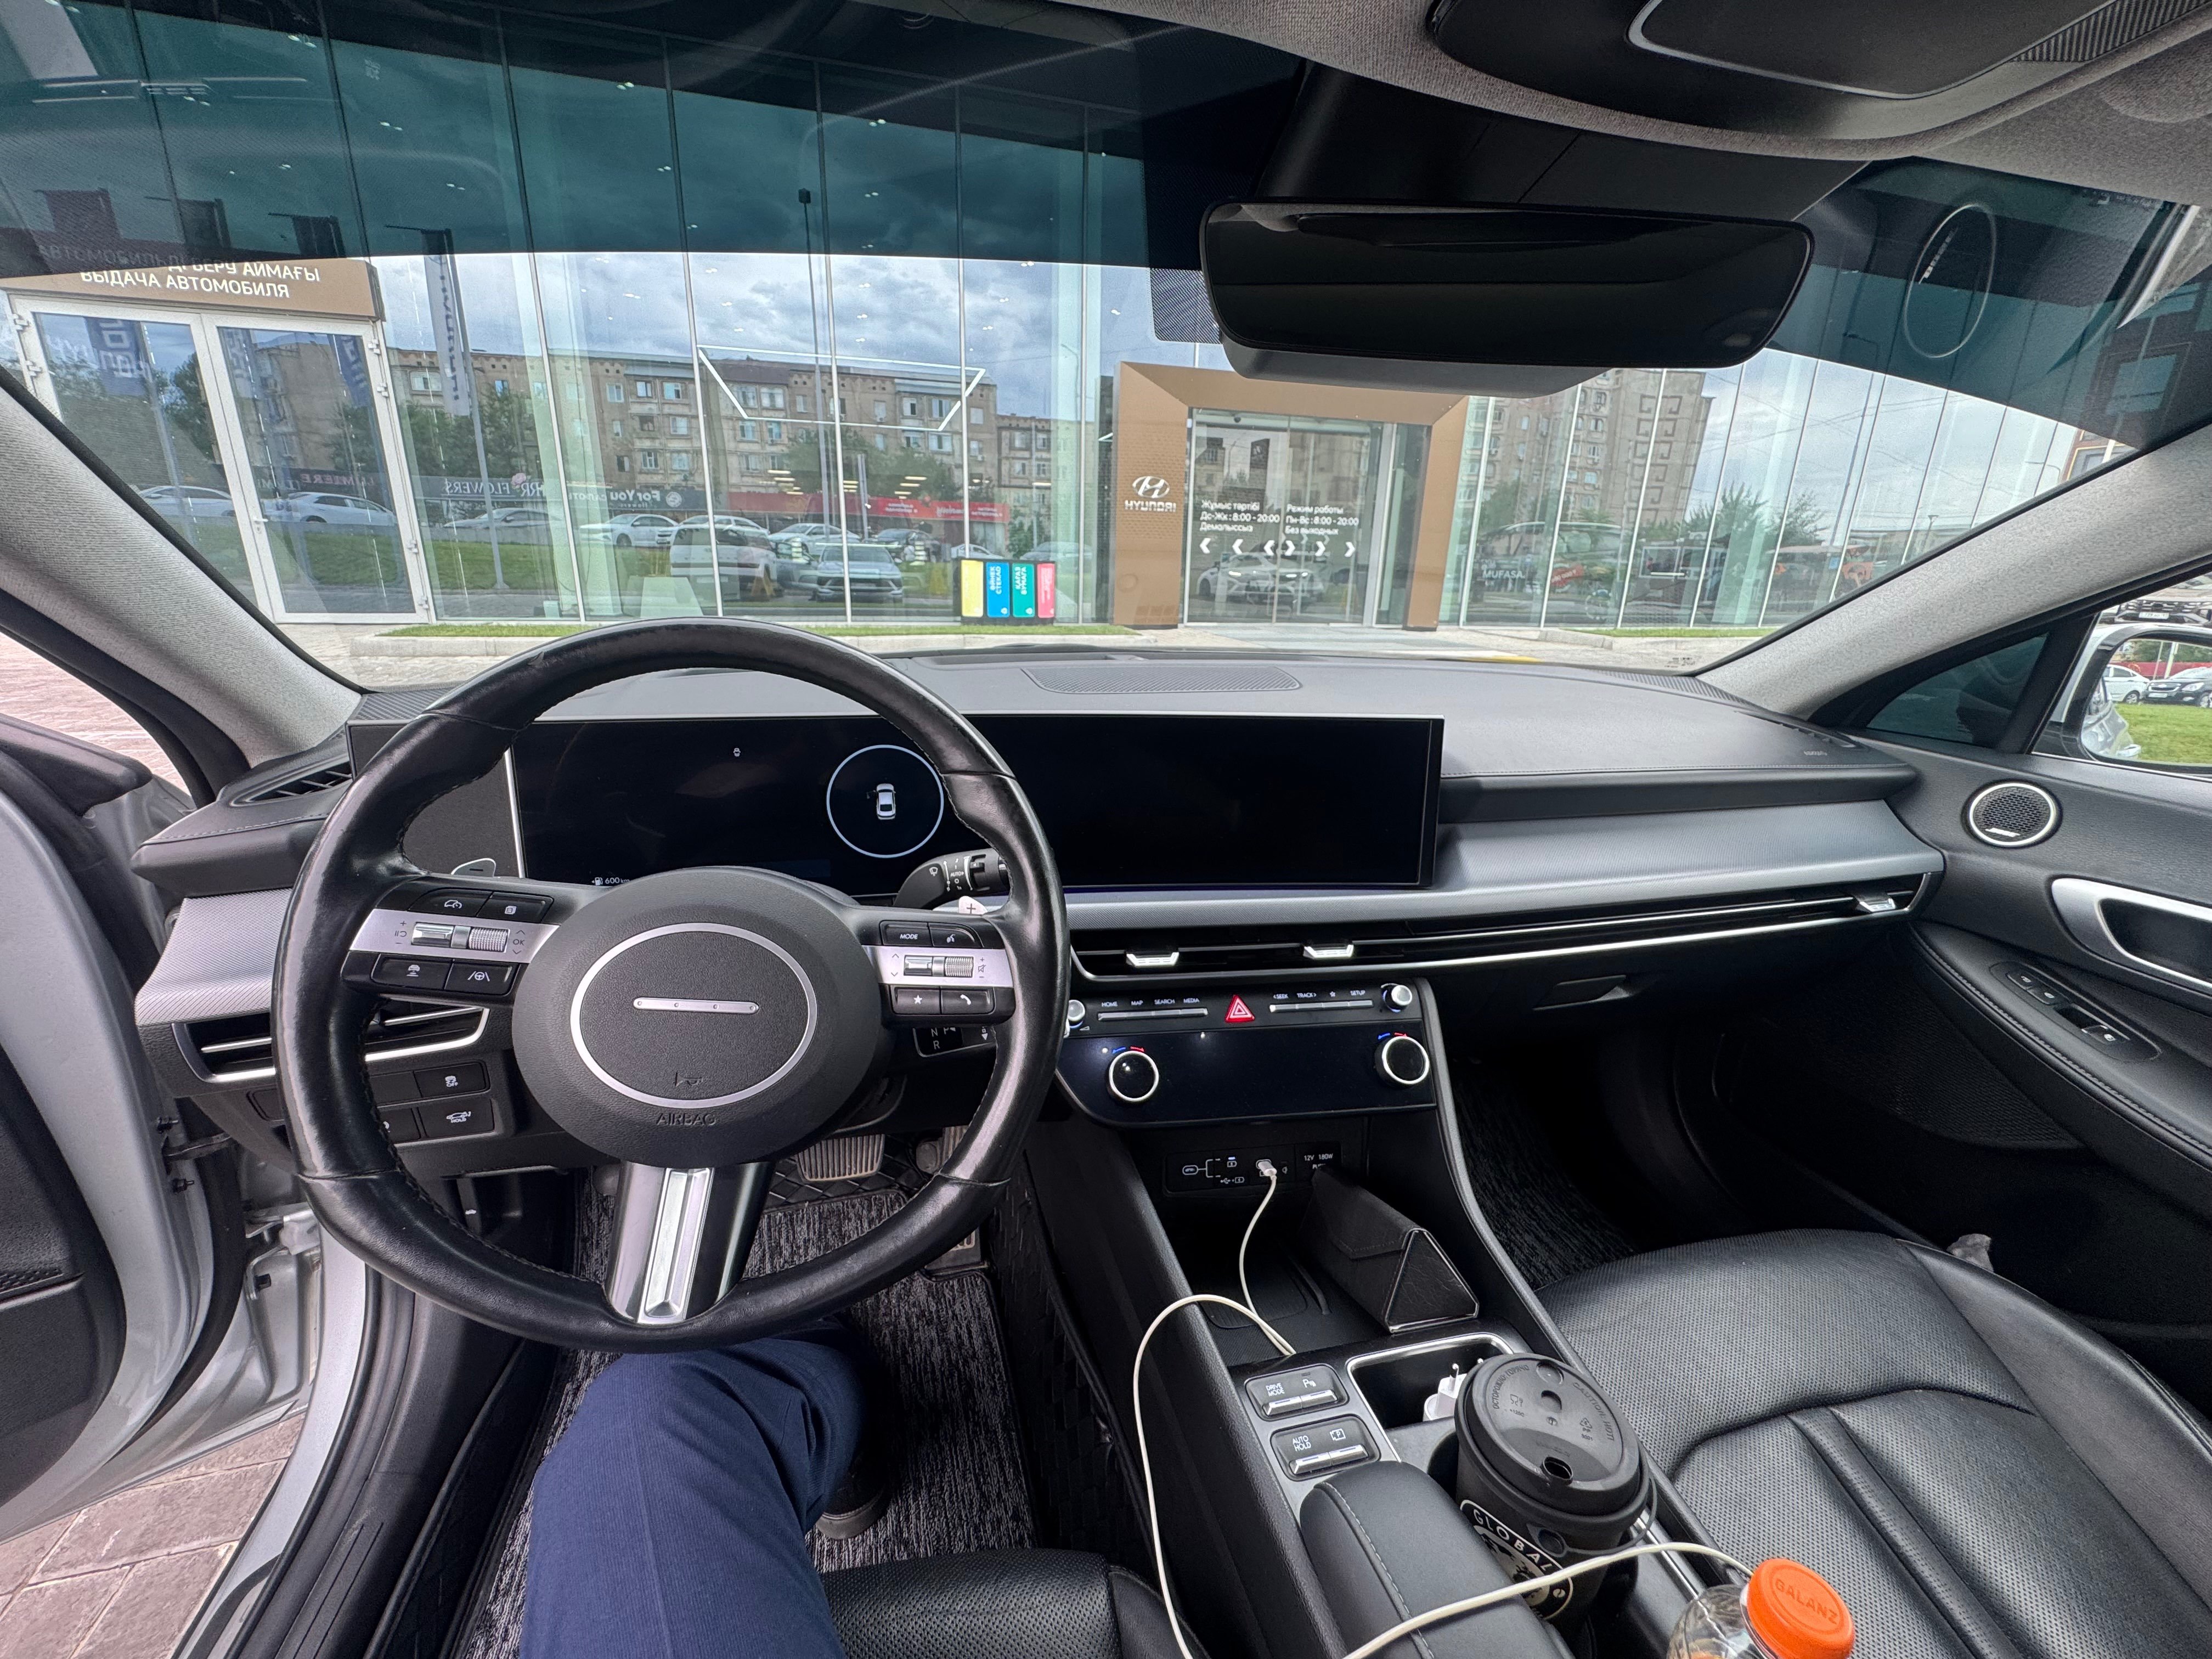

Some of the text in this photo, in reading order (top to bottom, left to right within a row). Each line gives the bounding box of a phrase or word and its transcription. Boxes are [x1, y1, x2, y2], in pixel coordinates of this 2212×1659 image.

[80, 270, 290, 298] ВЫДАЧА АВТОМОБИЛЯ
[1125, 500, 1177, 512] HYUNDAI
[931, 1028, 938, 1036] N
[933, 1041, 940, 1049] R
[656, 1113, 716, 1126] AIRBAG
[1266, 1383, 1282, 1391] DRIVE
[1268, 1387, 1285, 1397] MODE
[1293, 1435, 1309, 1444] AUTO
[1294, 1442, 1311, 1452] HOLD
[1474, 1509, 1552, 1571] GLOBAL
[1775, 1578, 1837, 1624] GALANZ
